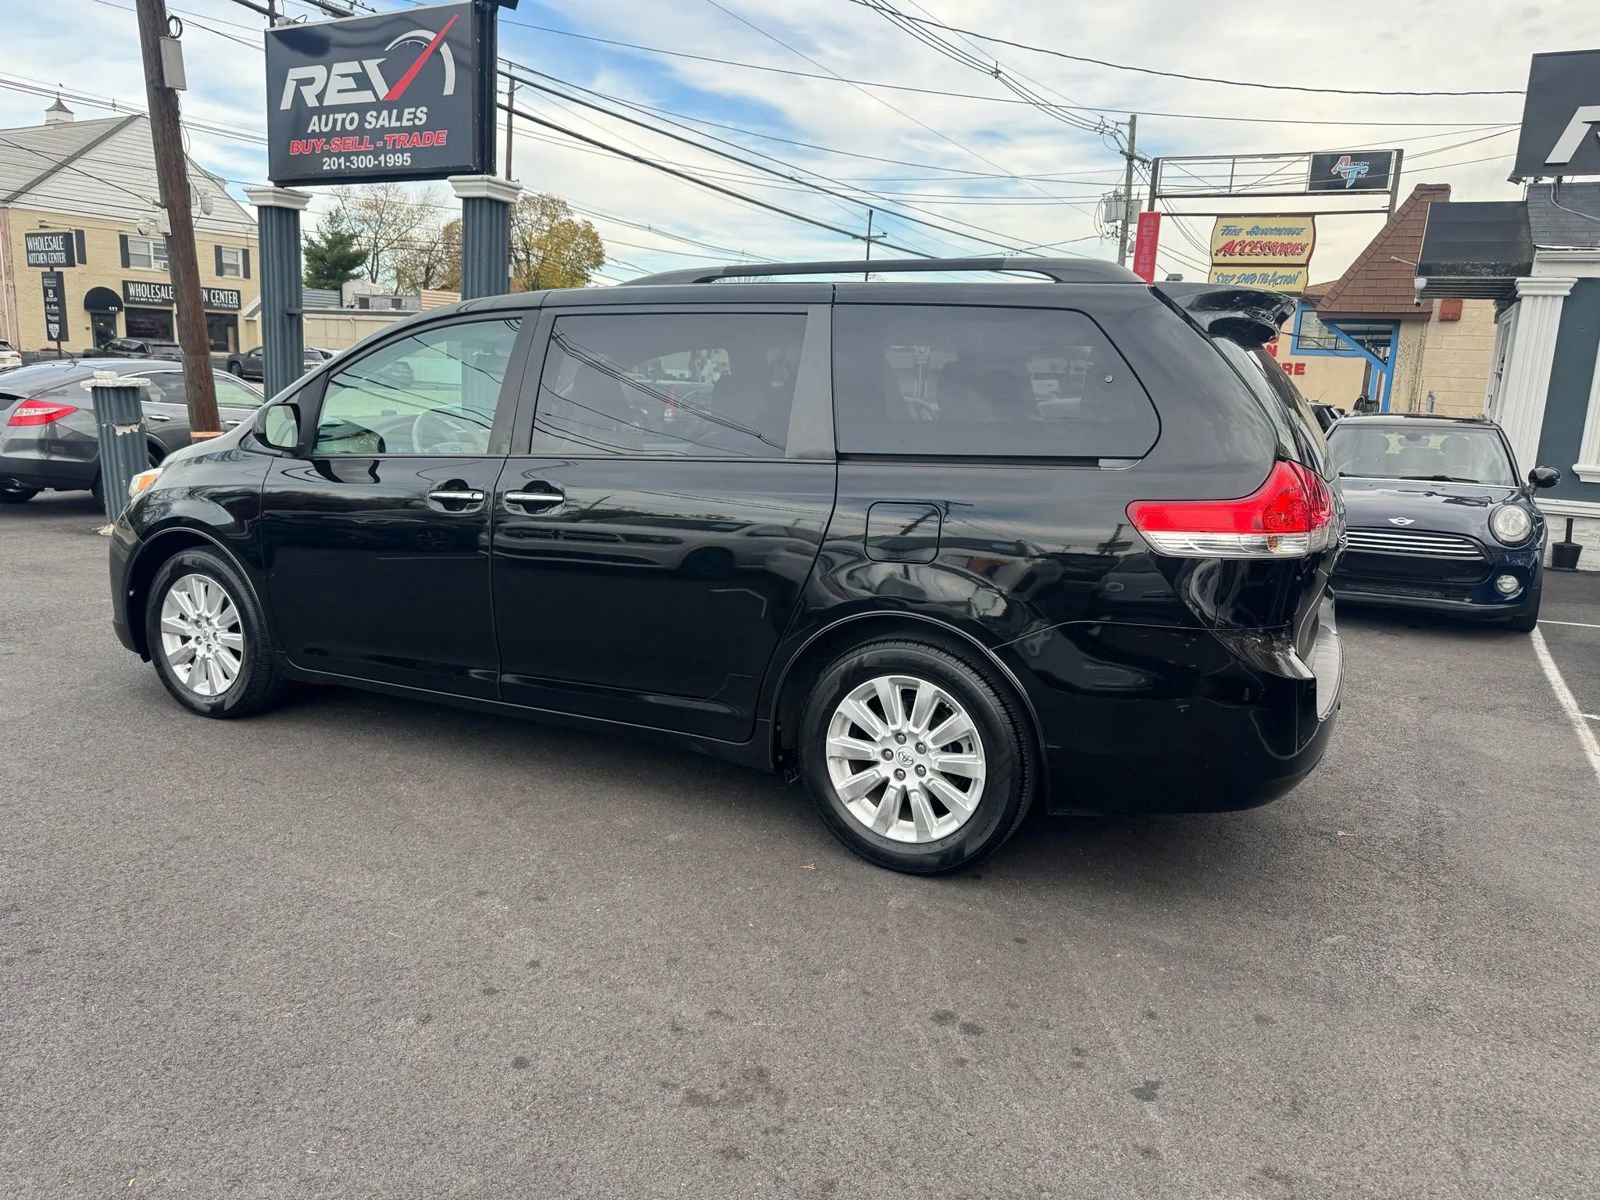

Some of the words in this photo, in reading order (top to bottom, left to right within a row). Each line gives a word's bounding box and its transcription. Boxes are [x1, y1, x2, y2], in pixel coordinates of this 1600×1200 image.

[307, 112, 359, 133] AUTO
[364, 106, 428, 130] SALES
[322, 153, 412, 170] 201-300-1995
[26, 235, 65, 252] WHOLESALE
[1214, 240, 1309, 257] ACCESSORIES
[28, 253, 48, 265] KITCHEN
[47, 252, 67, 264] CENTER
[128, 282, 174, 300] WHOLESALE
[210, 289, 239, 305] CENTER
